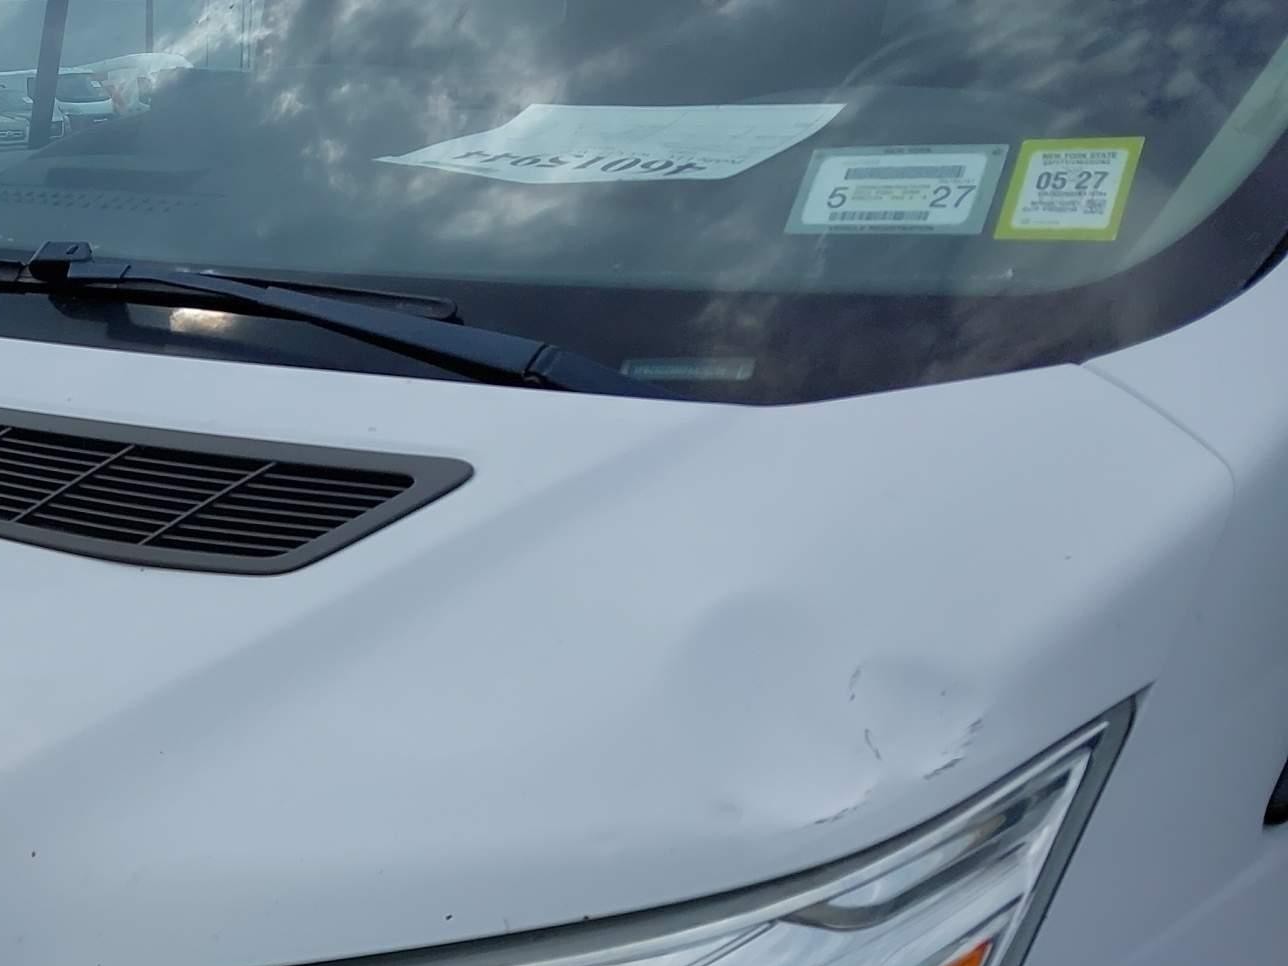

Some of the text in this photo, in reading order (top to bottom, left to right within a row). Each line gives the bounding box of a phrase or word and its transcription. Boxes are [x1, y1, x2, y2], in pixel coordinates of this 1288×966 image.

[454, 151, 707, 177] 46015944
[827, 186, 849, 208] 5
[929, 185, 977, 208] 27
